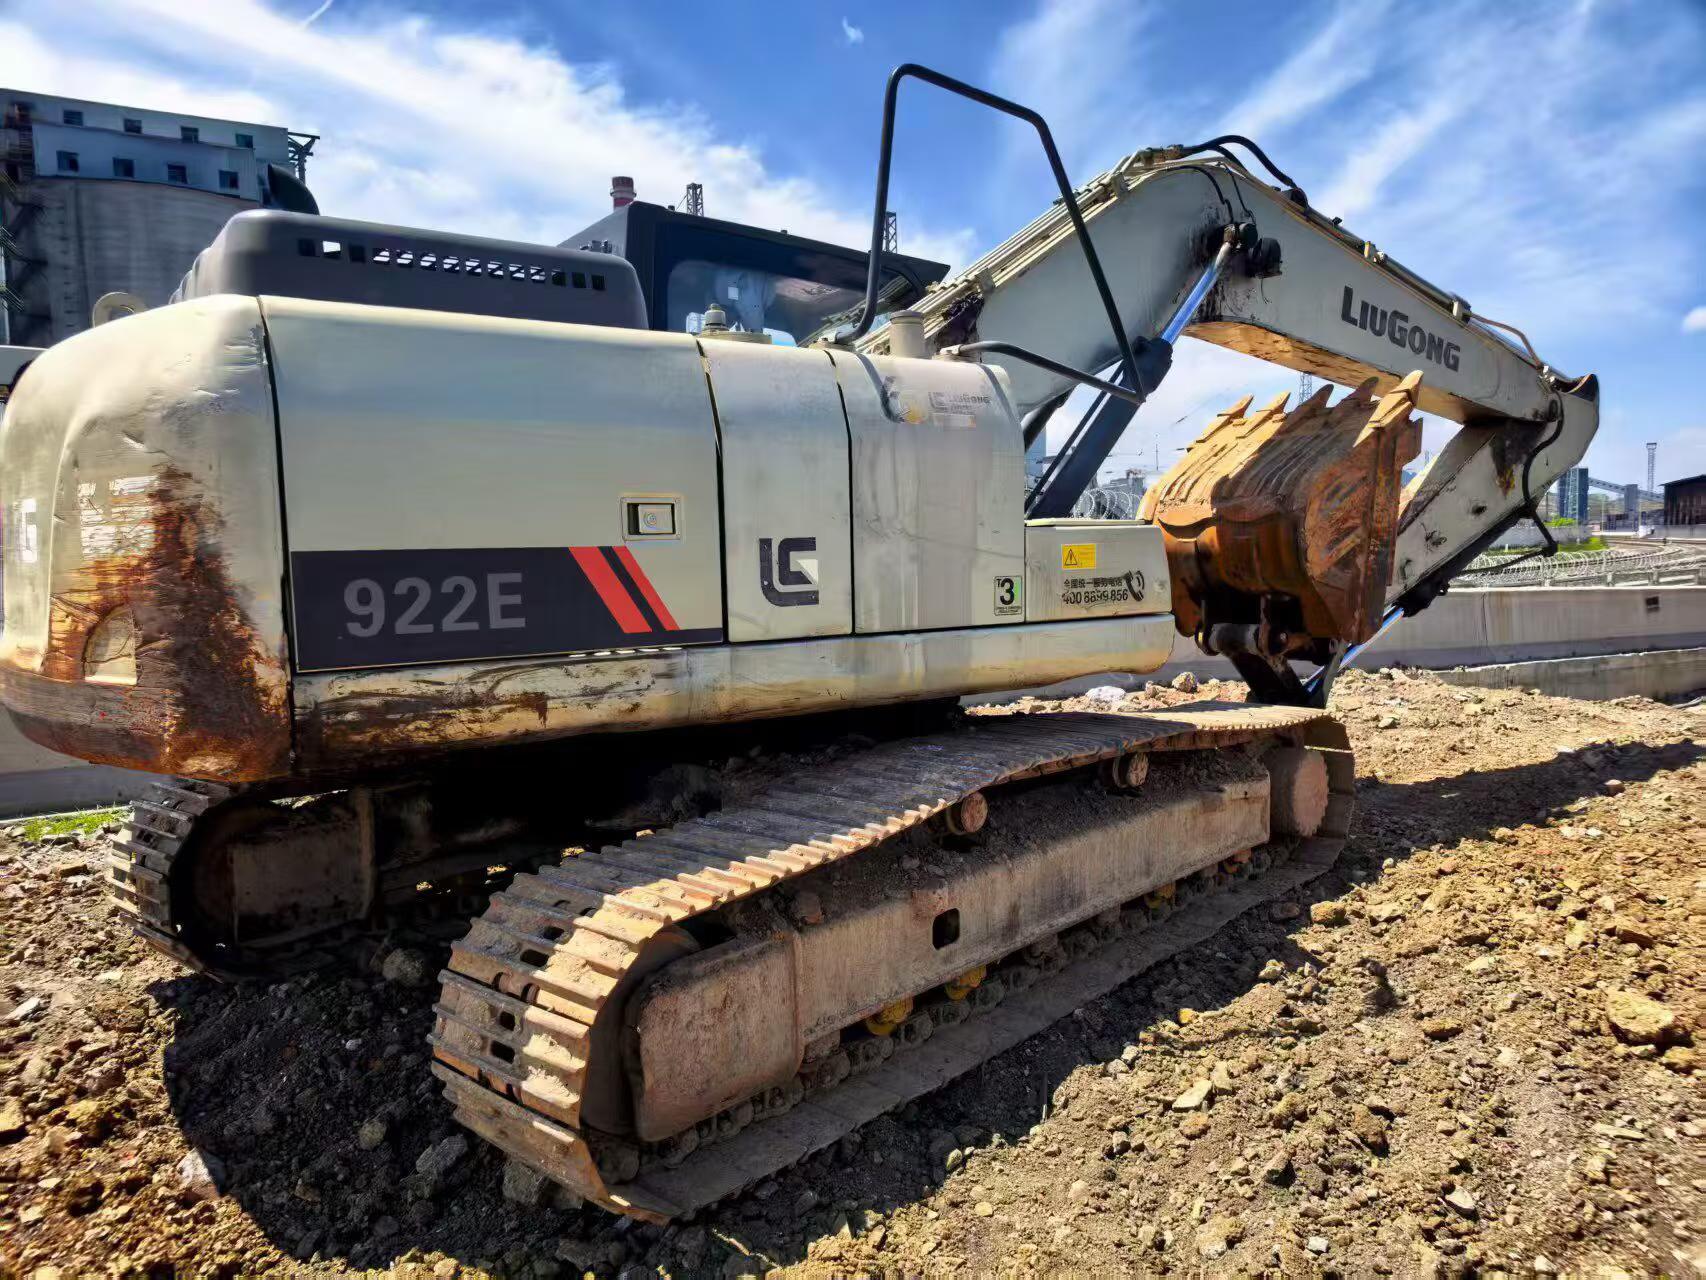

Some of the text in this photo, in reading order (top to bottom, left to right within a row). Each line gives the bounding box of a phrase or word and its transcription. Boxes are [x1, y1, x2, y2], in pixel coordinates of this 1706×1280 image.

[1341, 285, 1460, 372] LIUGONG
[343, 573, 526, 637] 922E
[1110, 589, 1128, 601] 856
